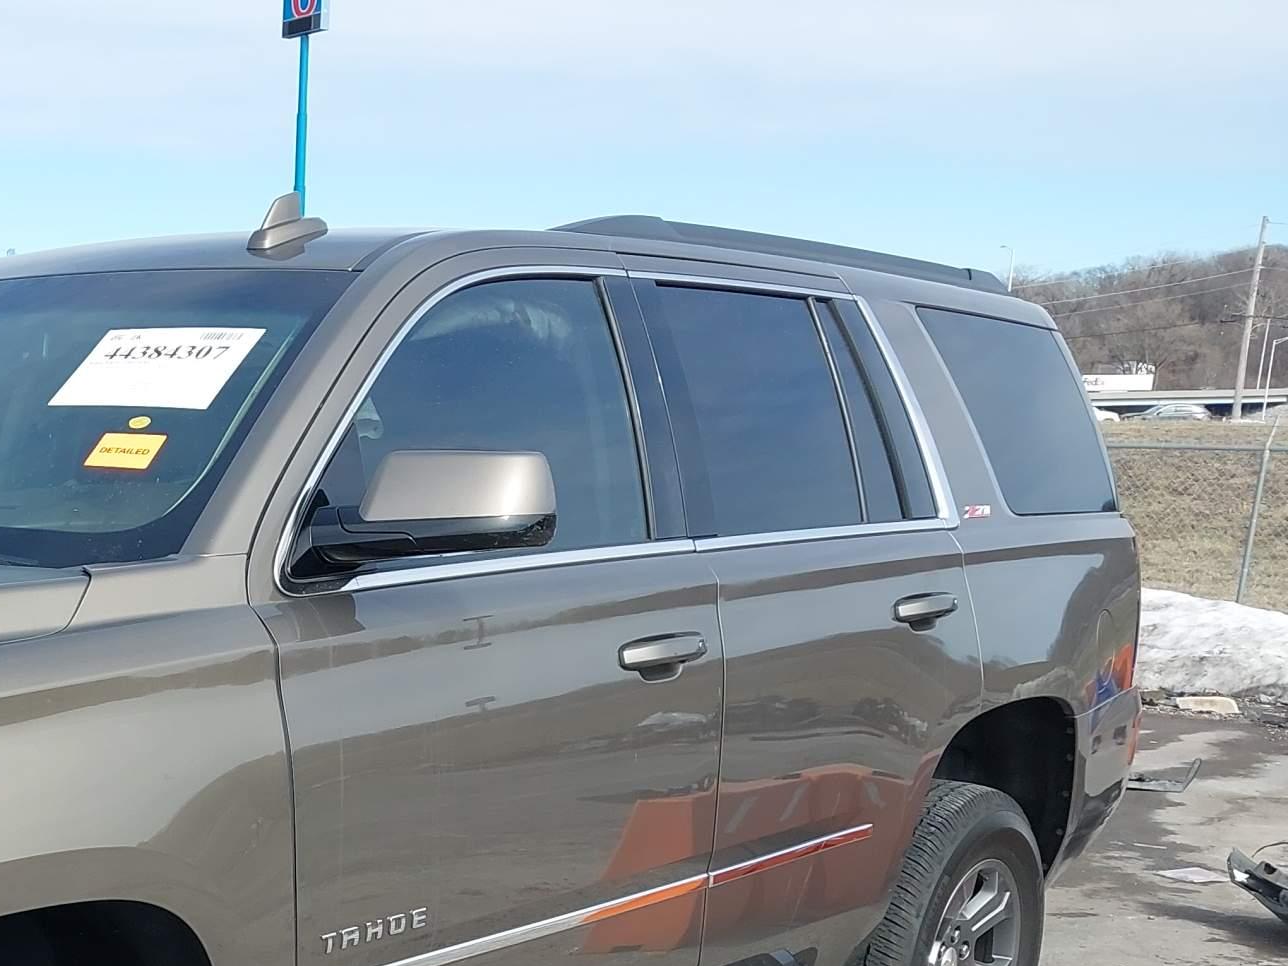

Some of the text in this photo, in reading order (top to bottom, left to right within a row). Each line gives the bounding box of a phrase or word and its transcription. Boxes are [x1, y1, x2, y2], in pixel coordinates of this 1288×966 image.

[103, 345, 231, 360] 44384307
[98, 446, 151, 456] DETAILED
[320, 906, 428, 954] TAHOE
